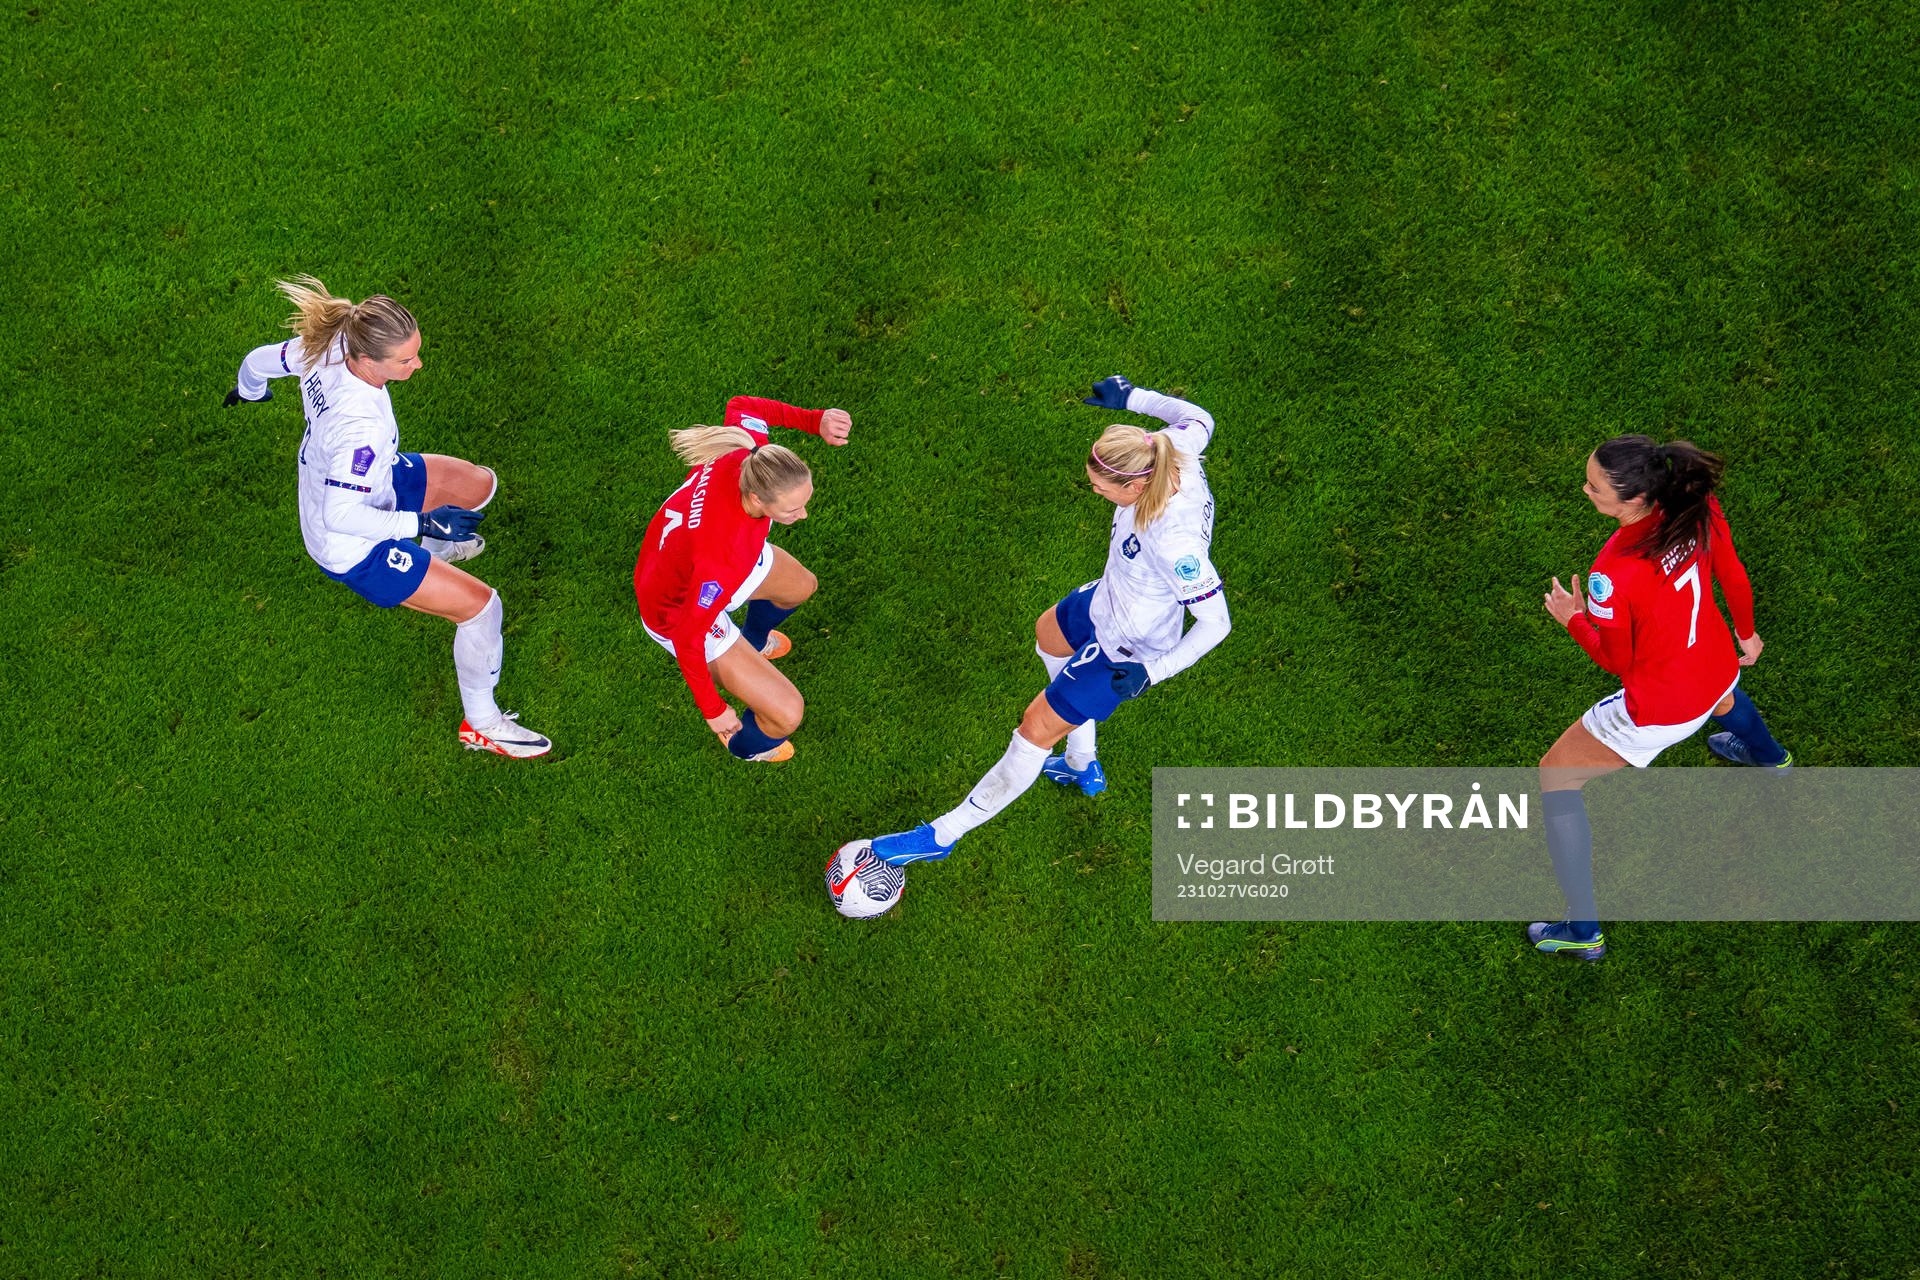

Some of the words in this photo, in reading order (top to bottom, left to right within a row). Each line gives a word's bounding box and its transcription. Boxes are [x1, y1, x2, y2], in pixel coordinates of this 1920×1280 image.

[304, 371, 329, 418] HENRY
[1673, 561, 1702, 648] 7
[1071, 642, 1100, 668] 9
